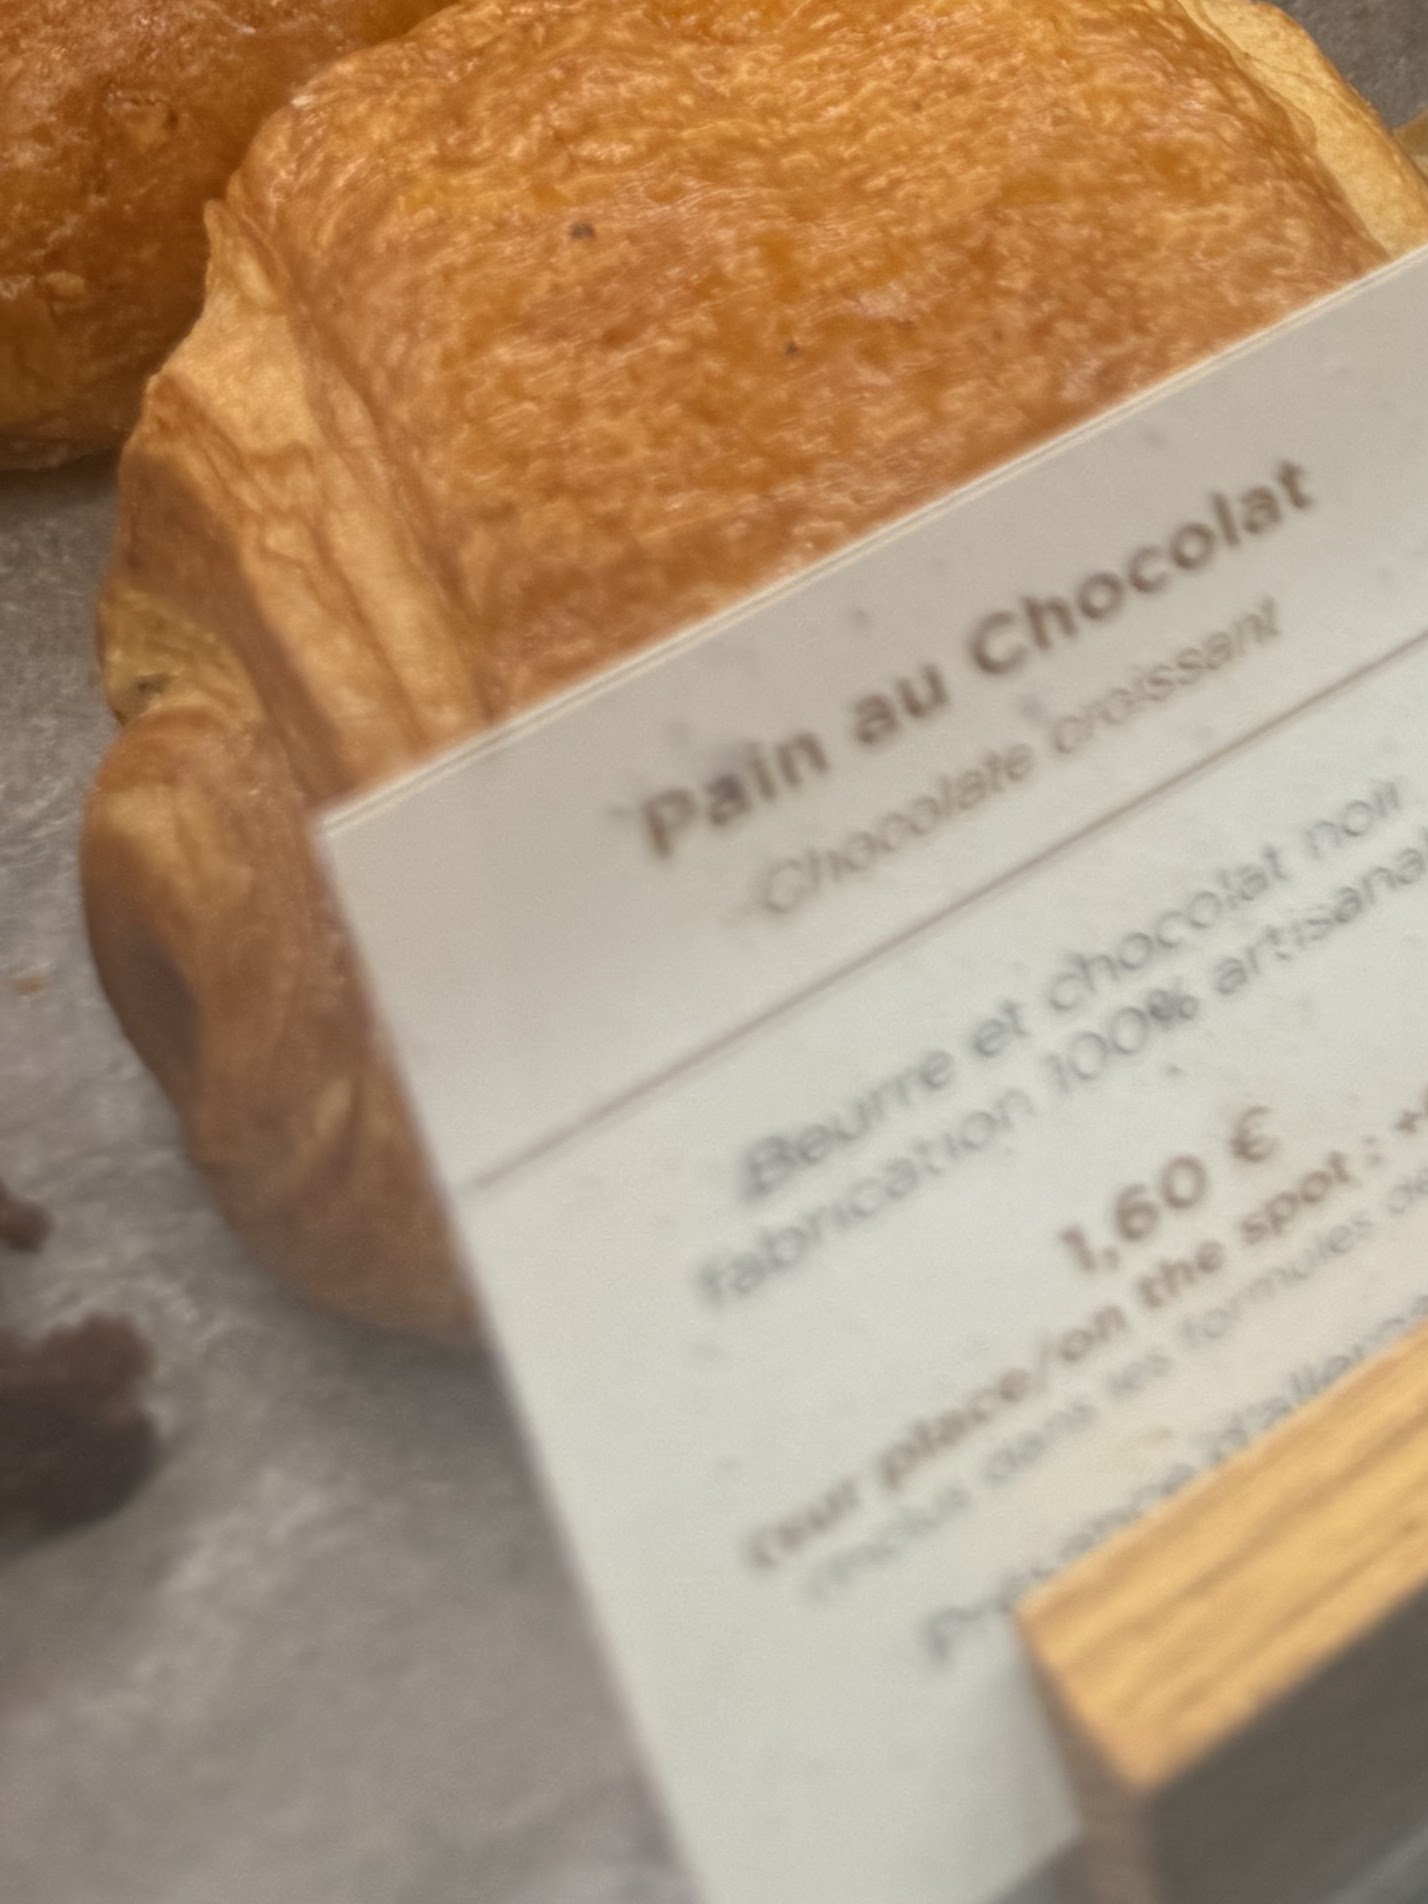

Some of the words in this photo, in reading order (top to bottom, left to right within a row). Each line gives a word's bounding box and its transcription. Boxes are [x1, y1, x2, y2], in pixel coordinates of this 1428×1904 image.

[641, 728, 833, 861] Pain
[852, 662, 950, 747] au
[969, 458, 1313, 678] Chocolat
[761, 741, 1033, 916] Chocolate
[1050, 597, 1281, 755] croissant
[697, 1088, 1033, 1313] fabrication
[1048, 985, 1199, 1097] 100%
[742, 1048, 956, 1204] Beurre
[970, 1001, 1031, 1061] et
[1046, 841, 1288, 1016] chocolat
[1304, 779, 1405, 858] noir
[1060, 1154, 1208, 1273] 1,60
[1229, 1105, 1277, 1163] €
[1137, 1239, 1226, 1308] the
[1241, 1149, 1355, 1244] spot
